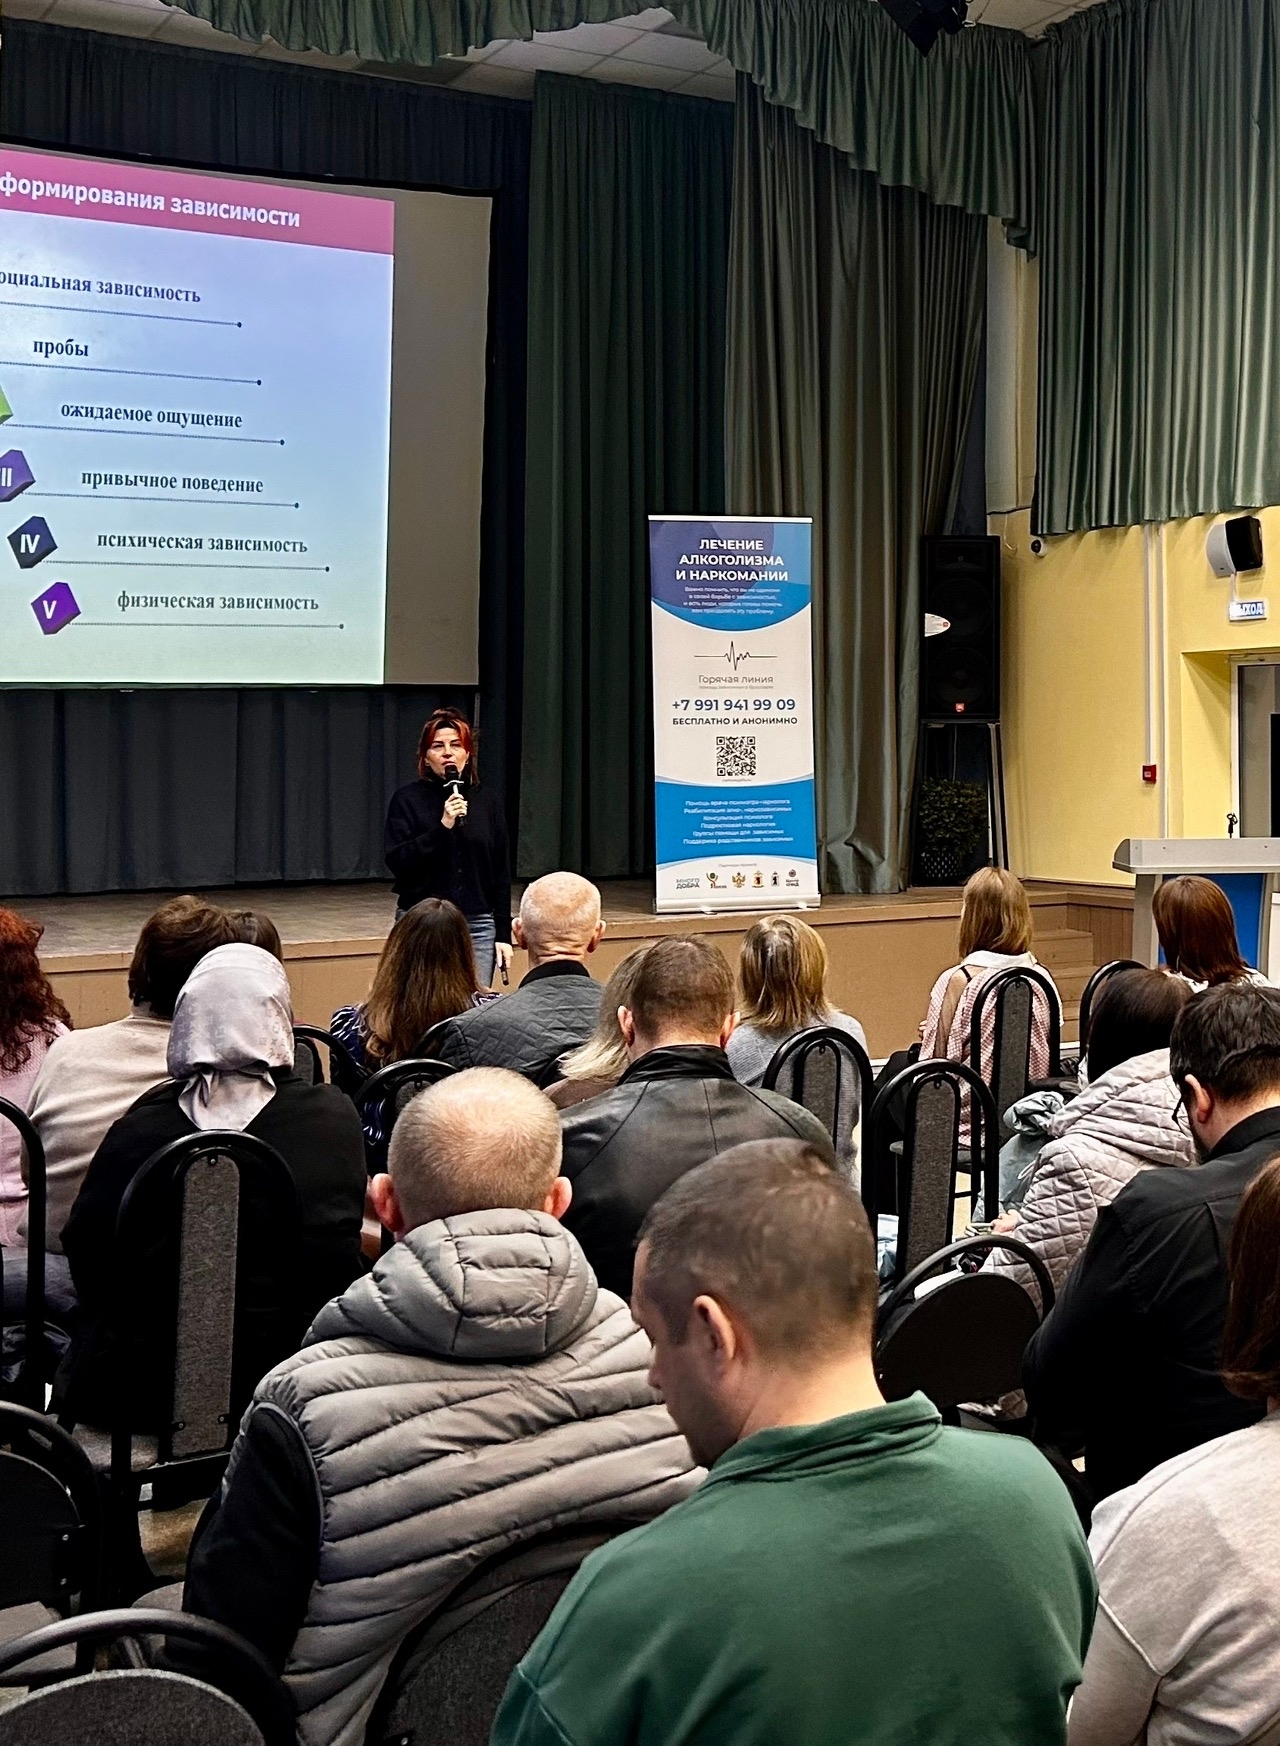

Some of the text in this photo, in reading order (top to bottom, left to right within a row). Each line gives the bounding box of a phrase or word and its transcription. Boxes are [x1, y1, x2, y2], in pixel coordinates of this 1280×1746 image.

[0, 171, 300, 228] формирования зависимости
[96, 280, 201, 303] зависимость
[33, 338, 89, 358] пробы
[61, 403, 243, 429] ожидаемое ощущение
[81, 470, 264, 493] привычное поведение
[20, 533, 40, 554] IV
[97, 532, 308, 553] психическая зависимость
[699, 539, 764, 551] ЛЕЧЕНИЕ
[679, 554, 784, 566] АЛКОГОЛИЗМА
[676, 570, 789, 581] И НАРКОМАНИИ
[43, 600, 57, 619] V
[117, 590, 319, 612] физическая зависимость
[699, 675, 739, 685] Горячая
[672, 699, 795, 711] +7 991 941 99 09
[673, 717, 798, 725] БЕСПЛАТНО И АНОНИМНО
